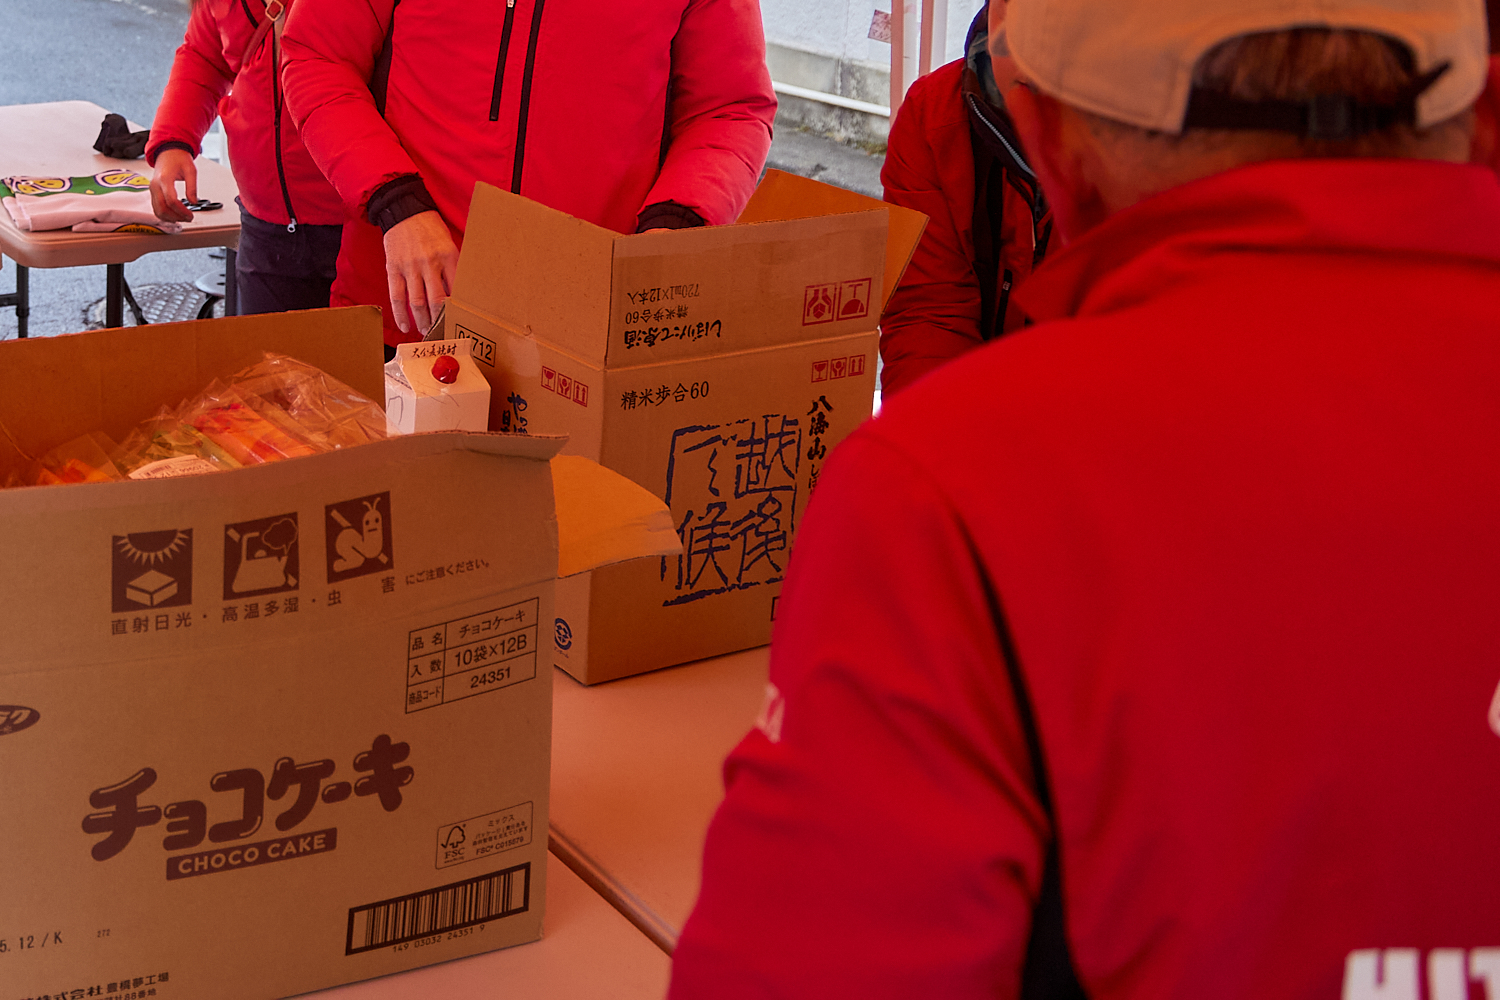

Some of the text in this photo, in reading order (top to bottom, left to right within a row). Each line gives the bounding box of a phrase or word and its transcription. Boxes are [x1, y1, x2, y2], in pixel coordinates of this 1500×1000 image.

[625, 304, 689, 324] 精米歩合60
[624, 319, 722, 349] しぼりたて原酒
[621, 381, 710, 411] 精米歩合60
[807, 395, 834, 460] 八海山
[111, 613, 193, 636] 直射日光
[221, 598, 299, 623] 高温多湿
[459, 610, 526, 639] チョコケーキ
[470, 667, 511, 689] 24351
[81, 734, 415, 862] チョコケーキ
[178, 833, 328, 875] CHOCO CAKE
[444, 847, 465, 859] FSC
[414, 935, 442, 948] 03032
[447, 928, 474, 940] 24351
